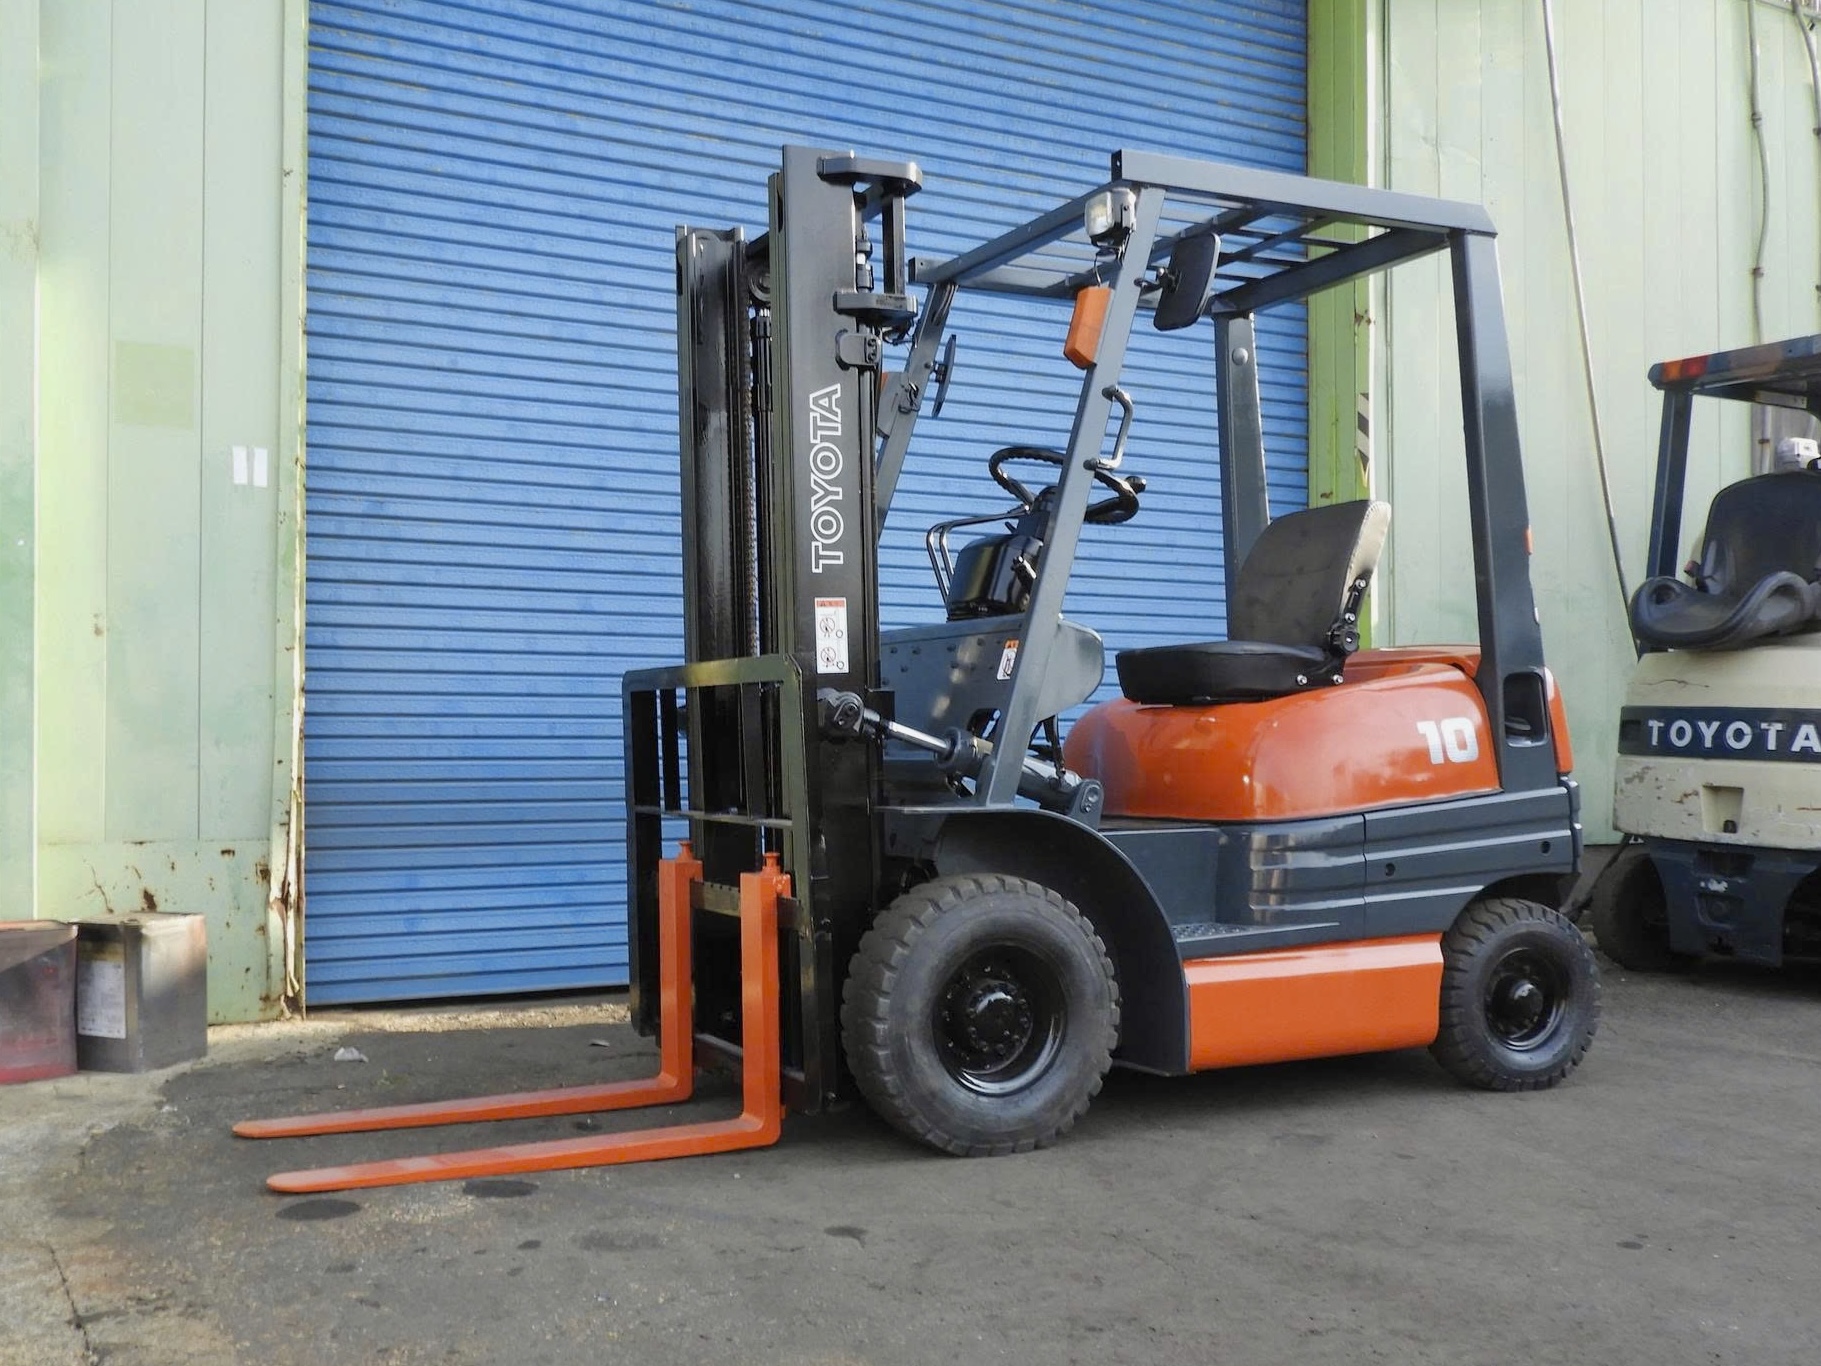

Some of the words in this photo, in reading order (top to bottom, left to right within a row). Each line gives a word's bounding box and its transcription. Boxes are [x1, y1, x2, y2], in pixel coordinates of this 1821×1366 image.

[809, 383, 844, 573] TOYOTA
[1416, 717, 1479, 765] 10
[1648, 719, 1821, 752] TOYOTA
